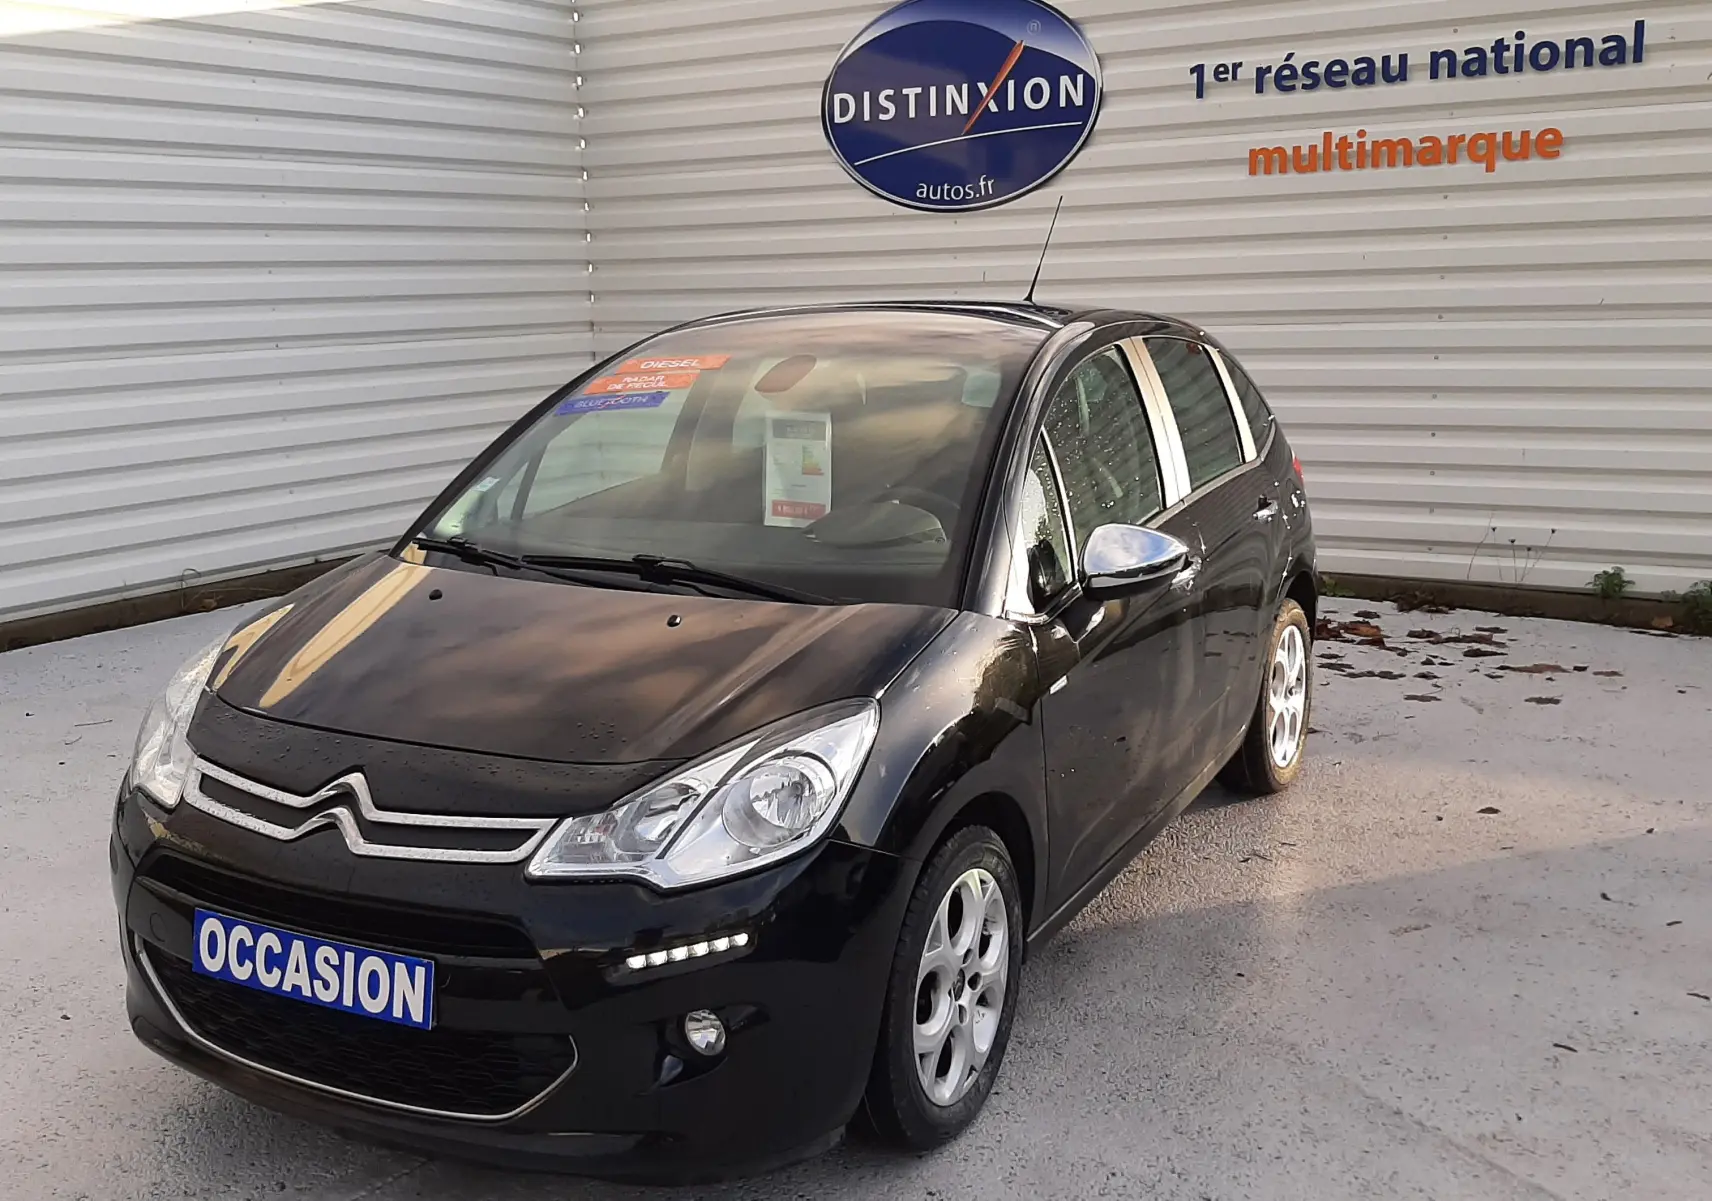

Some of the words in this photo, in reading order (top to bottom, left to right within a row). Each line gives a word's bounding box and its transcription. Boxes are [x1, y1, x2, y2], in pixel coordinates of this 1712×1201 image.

[1189, 61, 1242, 99] 1er
[1254, 52, 1408, 94] réseau
[1429, 19, 1645, 80] national
[833, 74, 1084, 124] DISTINXION
[1248, 127, 1564, 175] multimarque
[916, 175, 995, 200] autos.fr
[640, 359, 701, 369] DIESEL
[199, 917, 425, 1022] OCCASION
